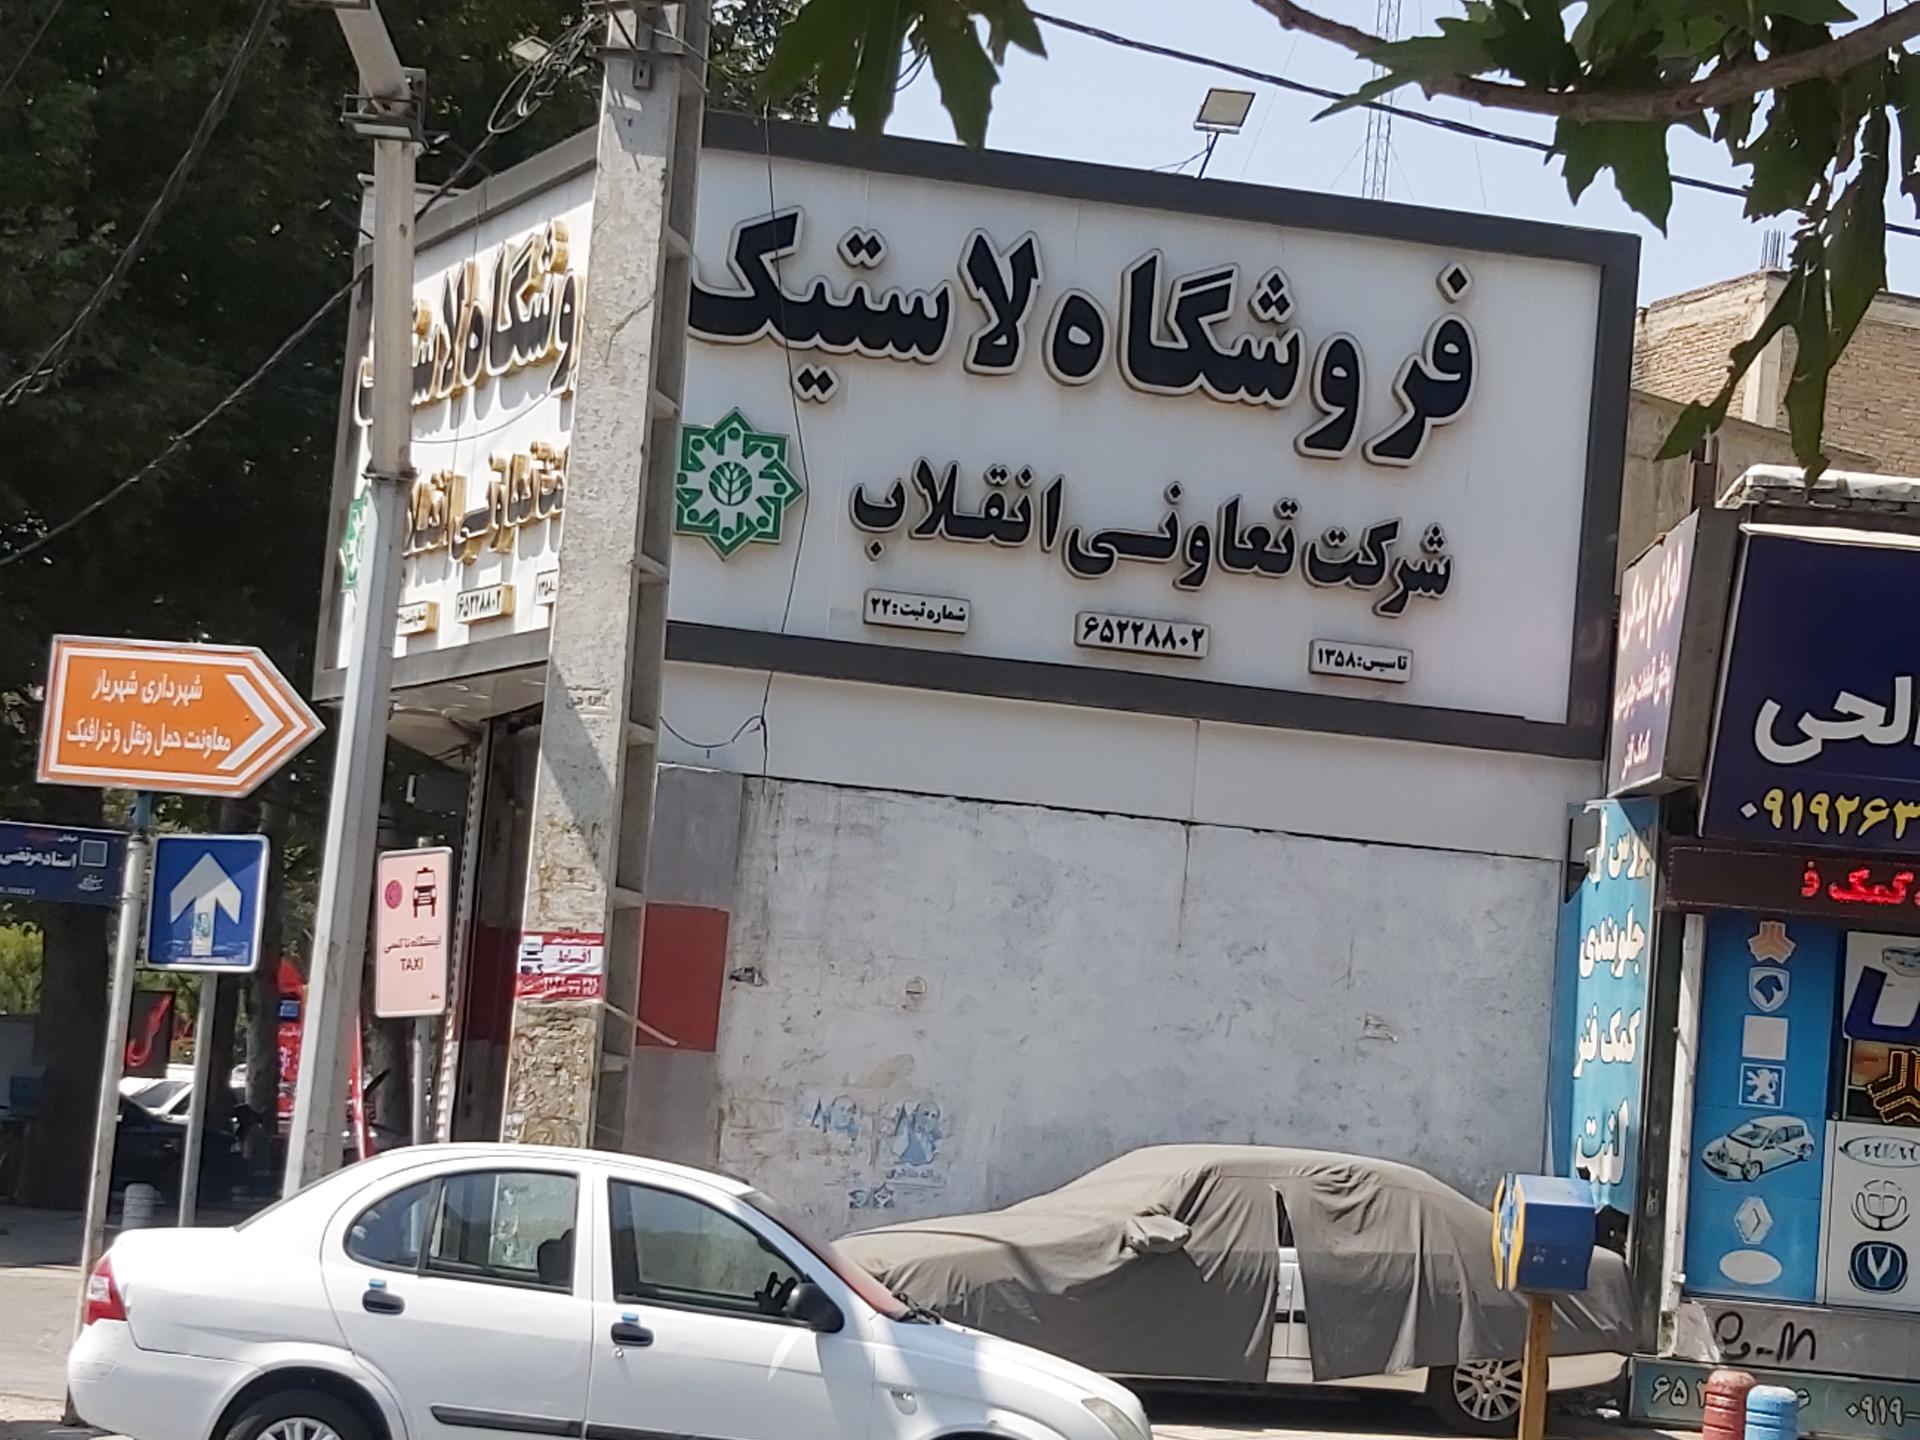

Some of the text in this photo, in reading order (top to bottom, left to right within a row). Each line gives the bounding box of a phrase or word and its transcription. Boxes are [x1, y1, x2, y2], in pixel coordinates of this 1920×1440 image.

[687, 206, 1477, 465] فروشگاه لاستیک
[850, 457, 1454, 617] شرکت تعاونی انقلاب
[927, 604, 967, 624] شماره
[1083, 616, 1205, 652] ۶۵۲۲۸۸۰۲
[91, 669, 203, 706] شهرداری شهریار
[66, 717, 113, 751] ترافیک
[153, 723, 182, 757] حمل
[184, 726, 232, 758] معاونت
[1579, 904, 1645, 978] جلوبندی
[400, 957, 424, 971] TAXI
[1572, 1002, 1642, 1079] کمک فنر
[1575, 1098, 1629, 1185] لنت
